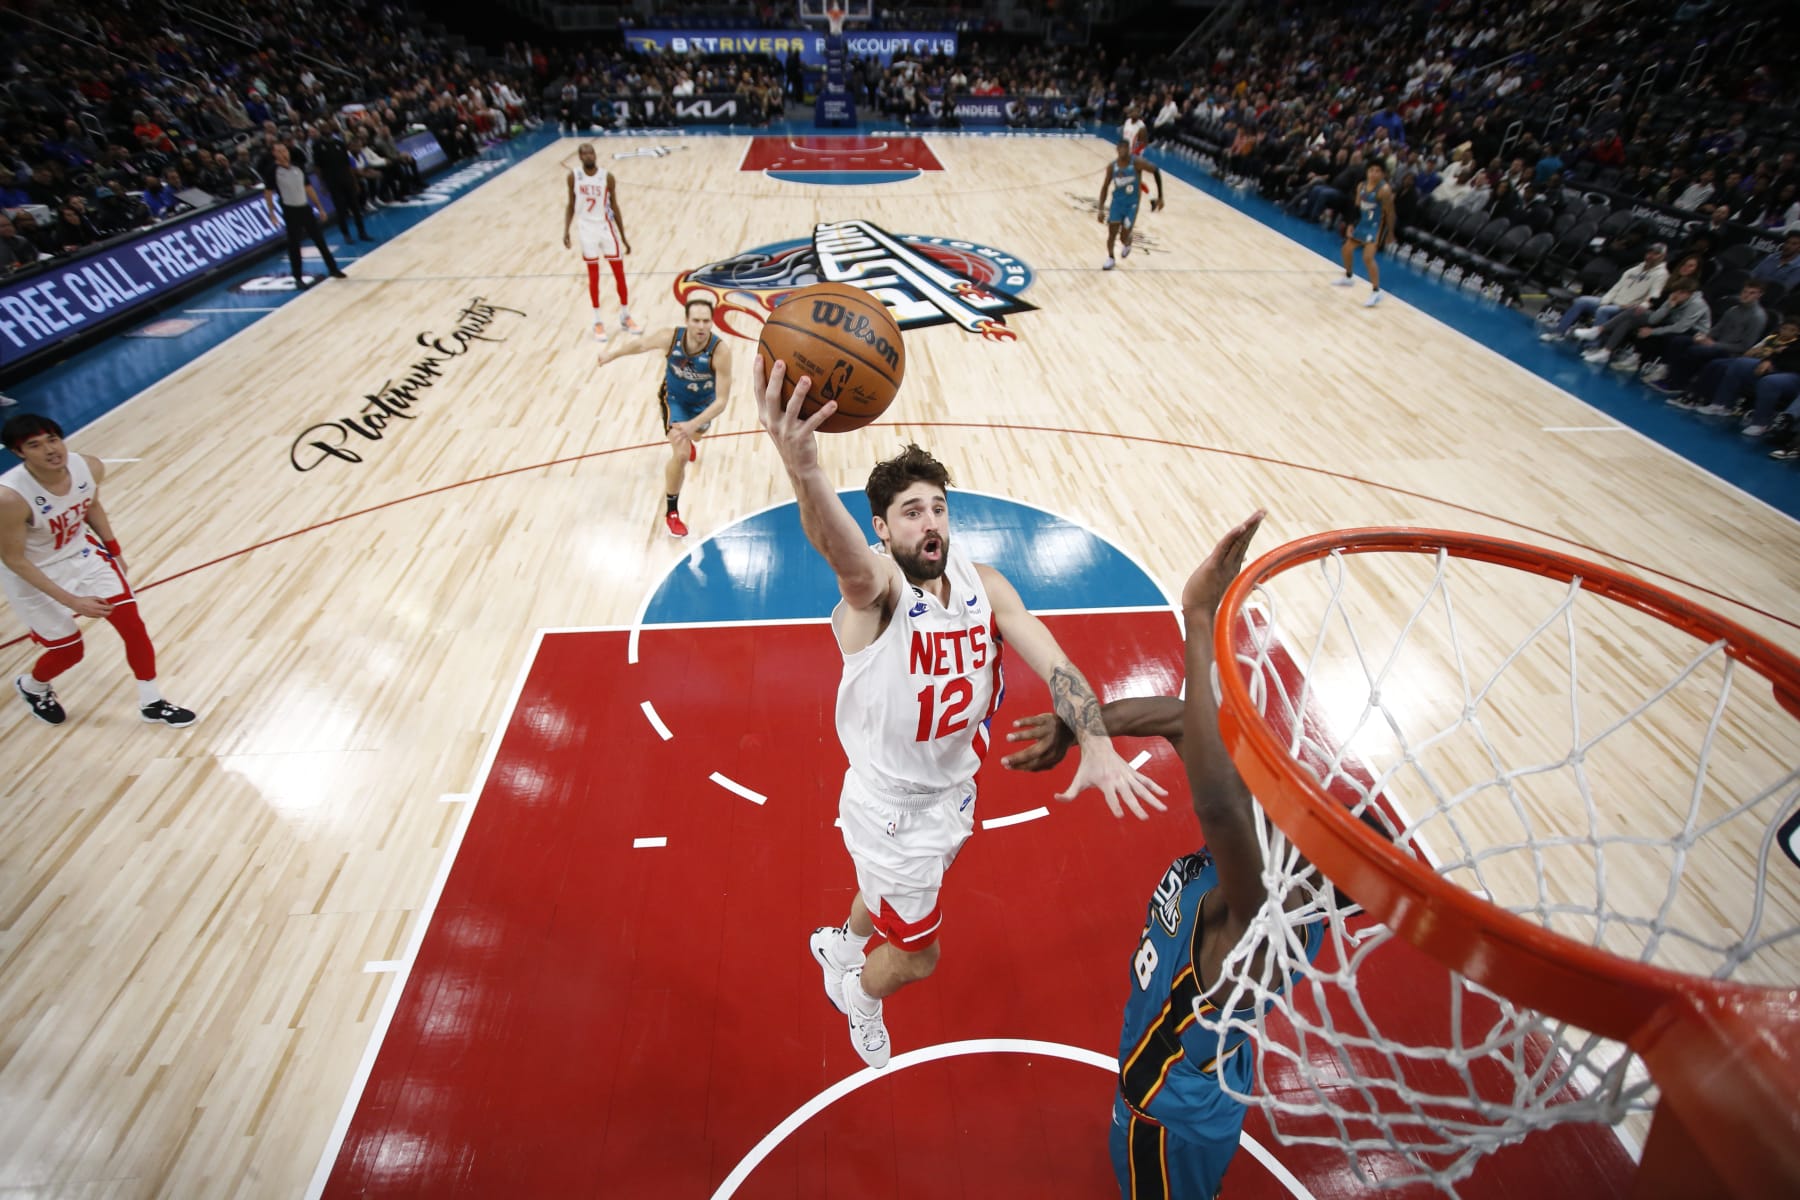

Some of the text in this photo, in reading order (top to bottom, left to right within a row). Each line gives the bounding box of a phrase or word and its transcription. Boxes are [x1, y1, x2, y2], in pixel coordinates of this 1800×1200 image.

[953, 104, 1001, 117] ANDUEL
[579, 185, 602, 196] NETS
[586, 198, 596, 212] 7
[63, 257, 156, 313] CALL.
[136, 230, 210, 283] FREE
[812, 300, 899, 372] Wilson
[291, 296, 527, 471] Platinum Equity
[910, 625, 987, 676] NETS
[916, 677, 973, 742] 12
